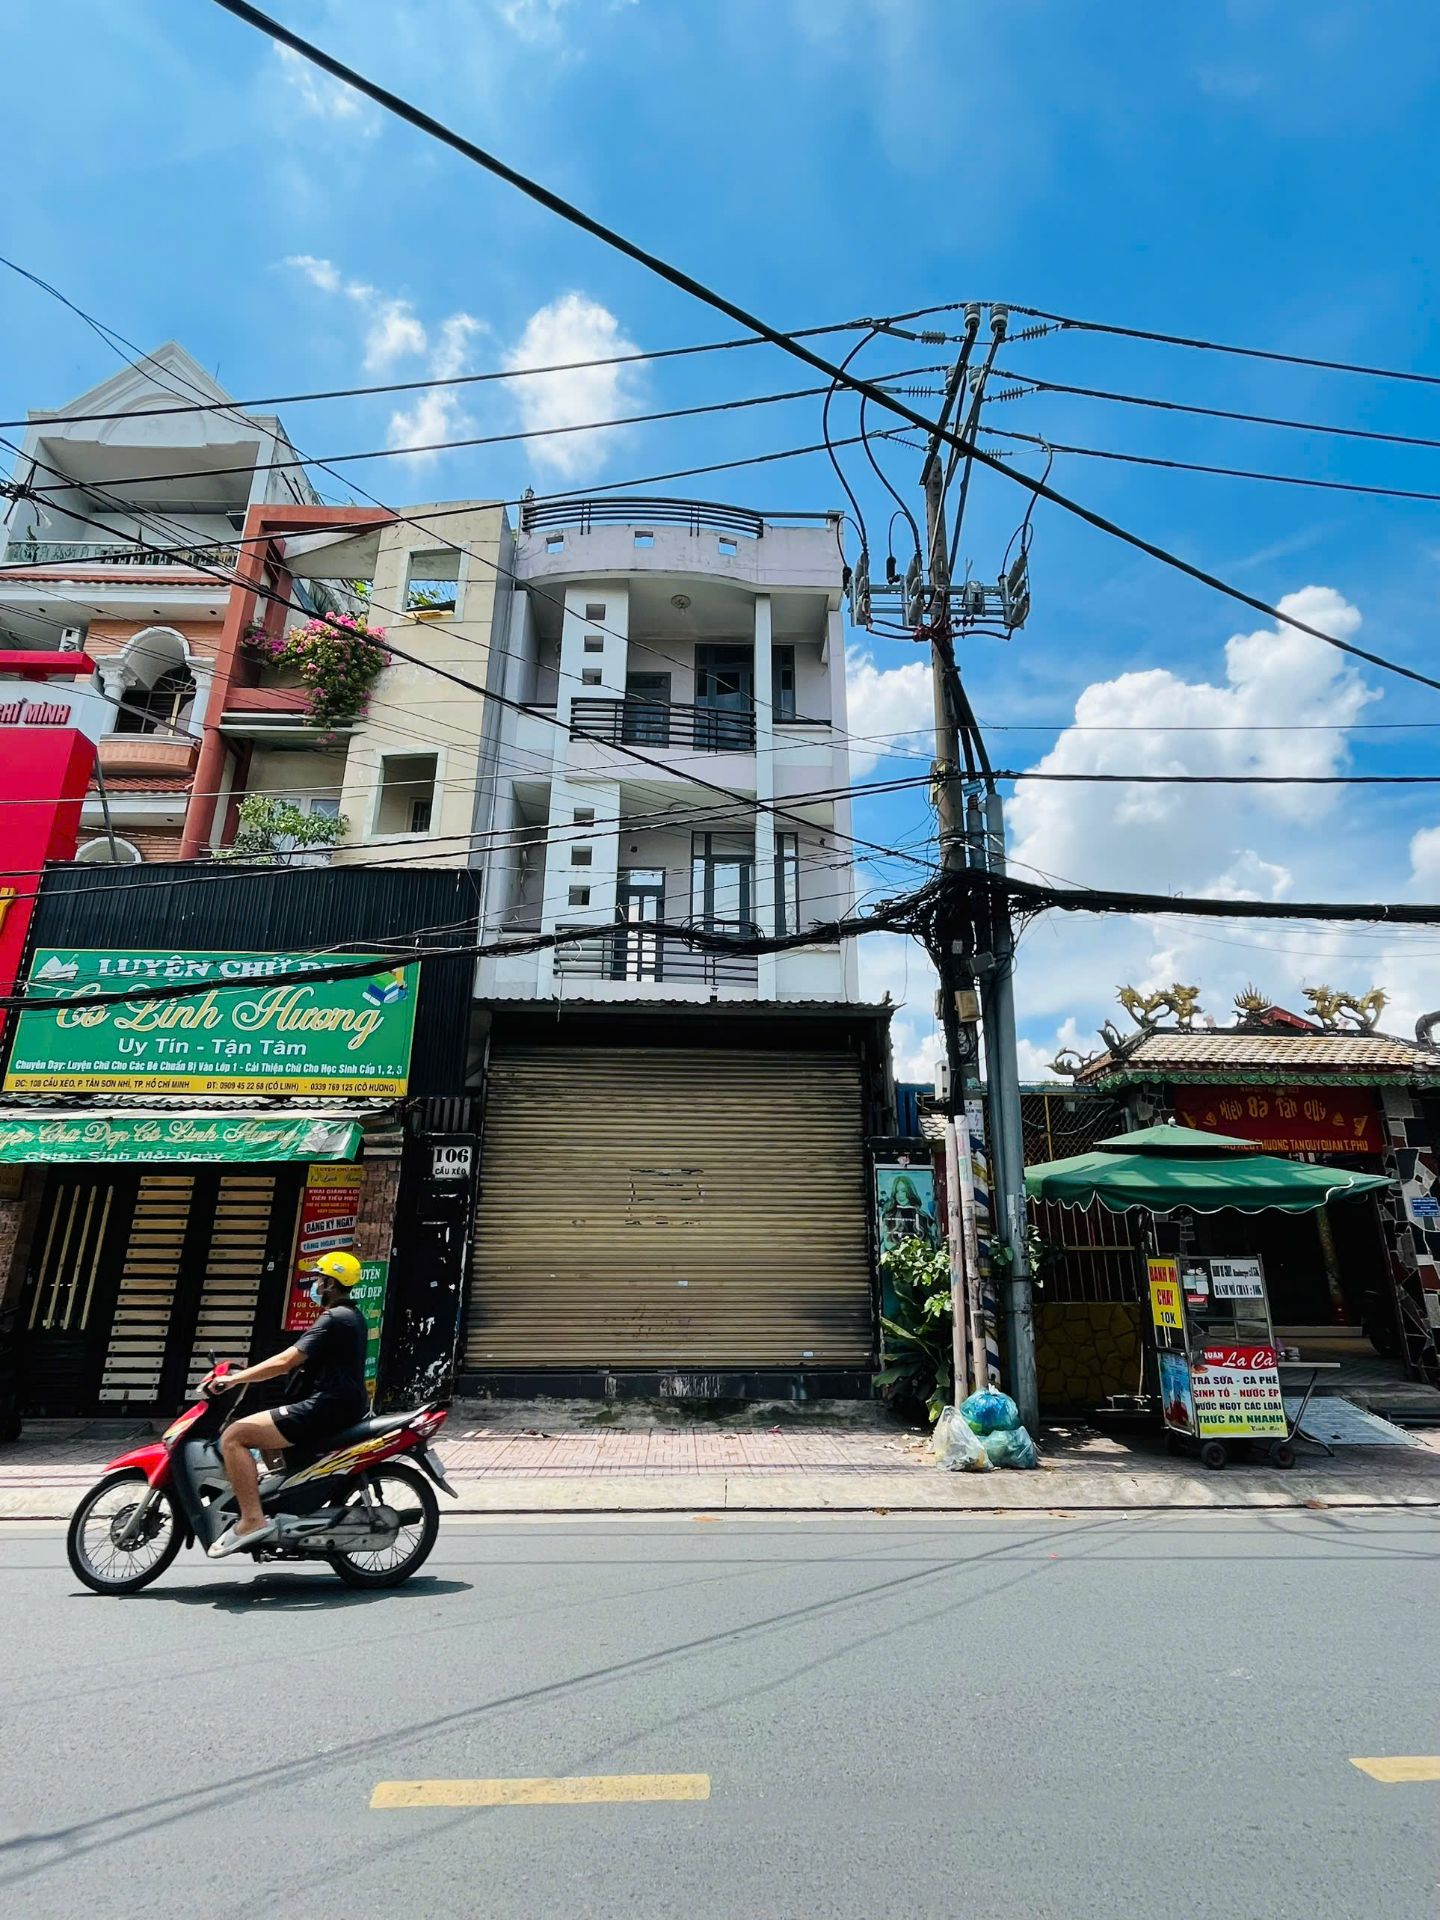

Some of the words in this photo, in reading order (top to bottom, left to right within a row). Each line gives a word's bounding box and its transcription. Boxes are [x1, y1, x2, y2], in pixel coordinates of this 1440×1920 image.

[232, 986, 384, 1050] Hương
[118, 1038, 148, 1057] Uy
[155, 1037, 189, 1054] Tín
[211, 1039, 251, 1058] Tận
[260, 1040, 307, 1056] Tâm
[67, 1060, 91, 1072] Luyện
[111, 1061, 127, 1071] Cho
[129, 1060, 145, 1071] Các
[187, 1062, 197, 1073] Bị
[199, 1062, 213, 1072] Vào
[215, 1062, 230, 1073] Lớp
[232, 1062, 237, 1072] 1
[261, 1063, 283, 1074] Thiện
[303, 1064, 318, 1073] Cho
[320, 1064, 337, 1075] Học
[339, 1064, 357, 1074] Sinh
[359, 1063, 375, 1075] Cấp
[435, 1148, 469, 1163] 106
[359, 1265, 381, 1283] UYỆN
[1160, 1311, 1177, 1325] 10K
[1222, 1351, 1248, 1367] La
[1250, 1350, 1275, 1369] Cà
[1213, 1375, 1234, 1385] SỮA
[1193, 1389, 1215, 1398] SINH
[1219, 1402, 1242, 1412] NGỌT
[1246, 1414, 1284, 1424] NHANH
